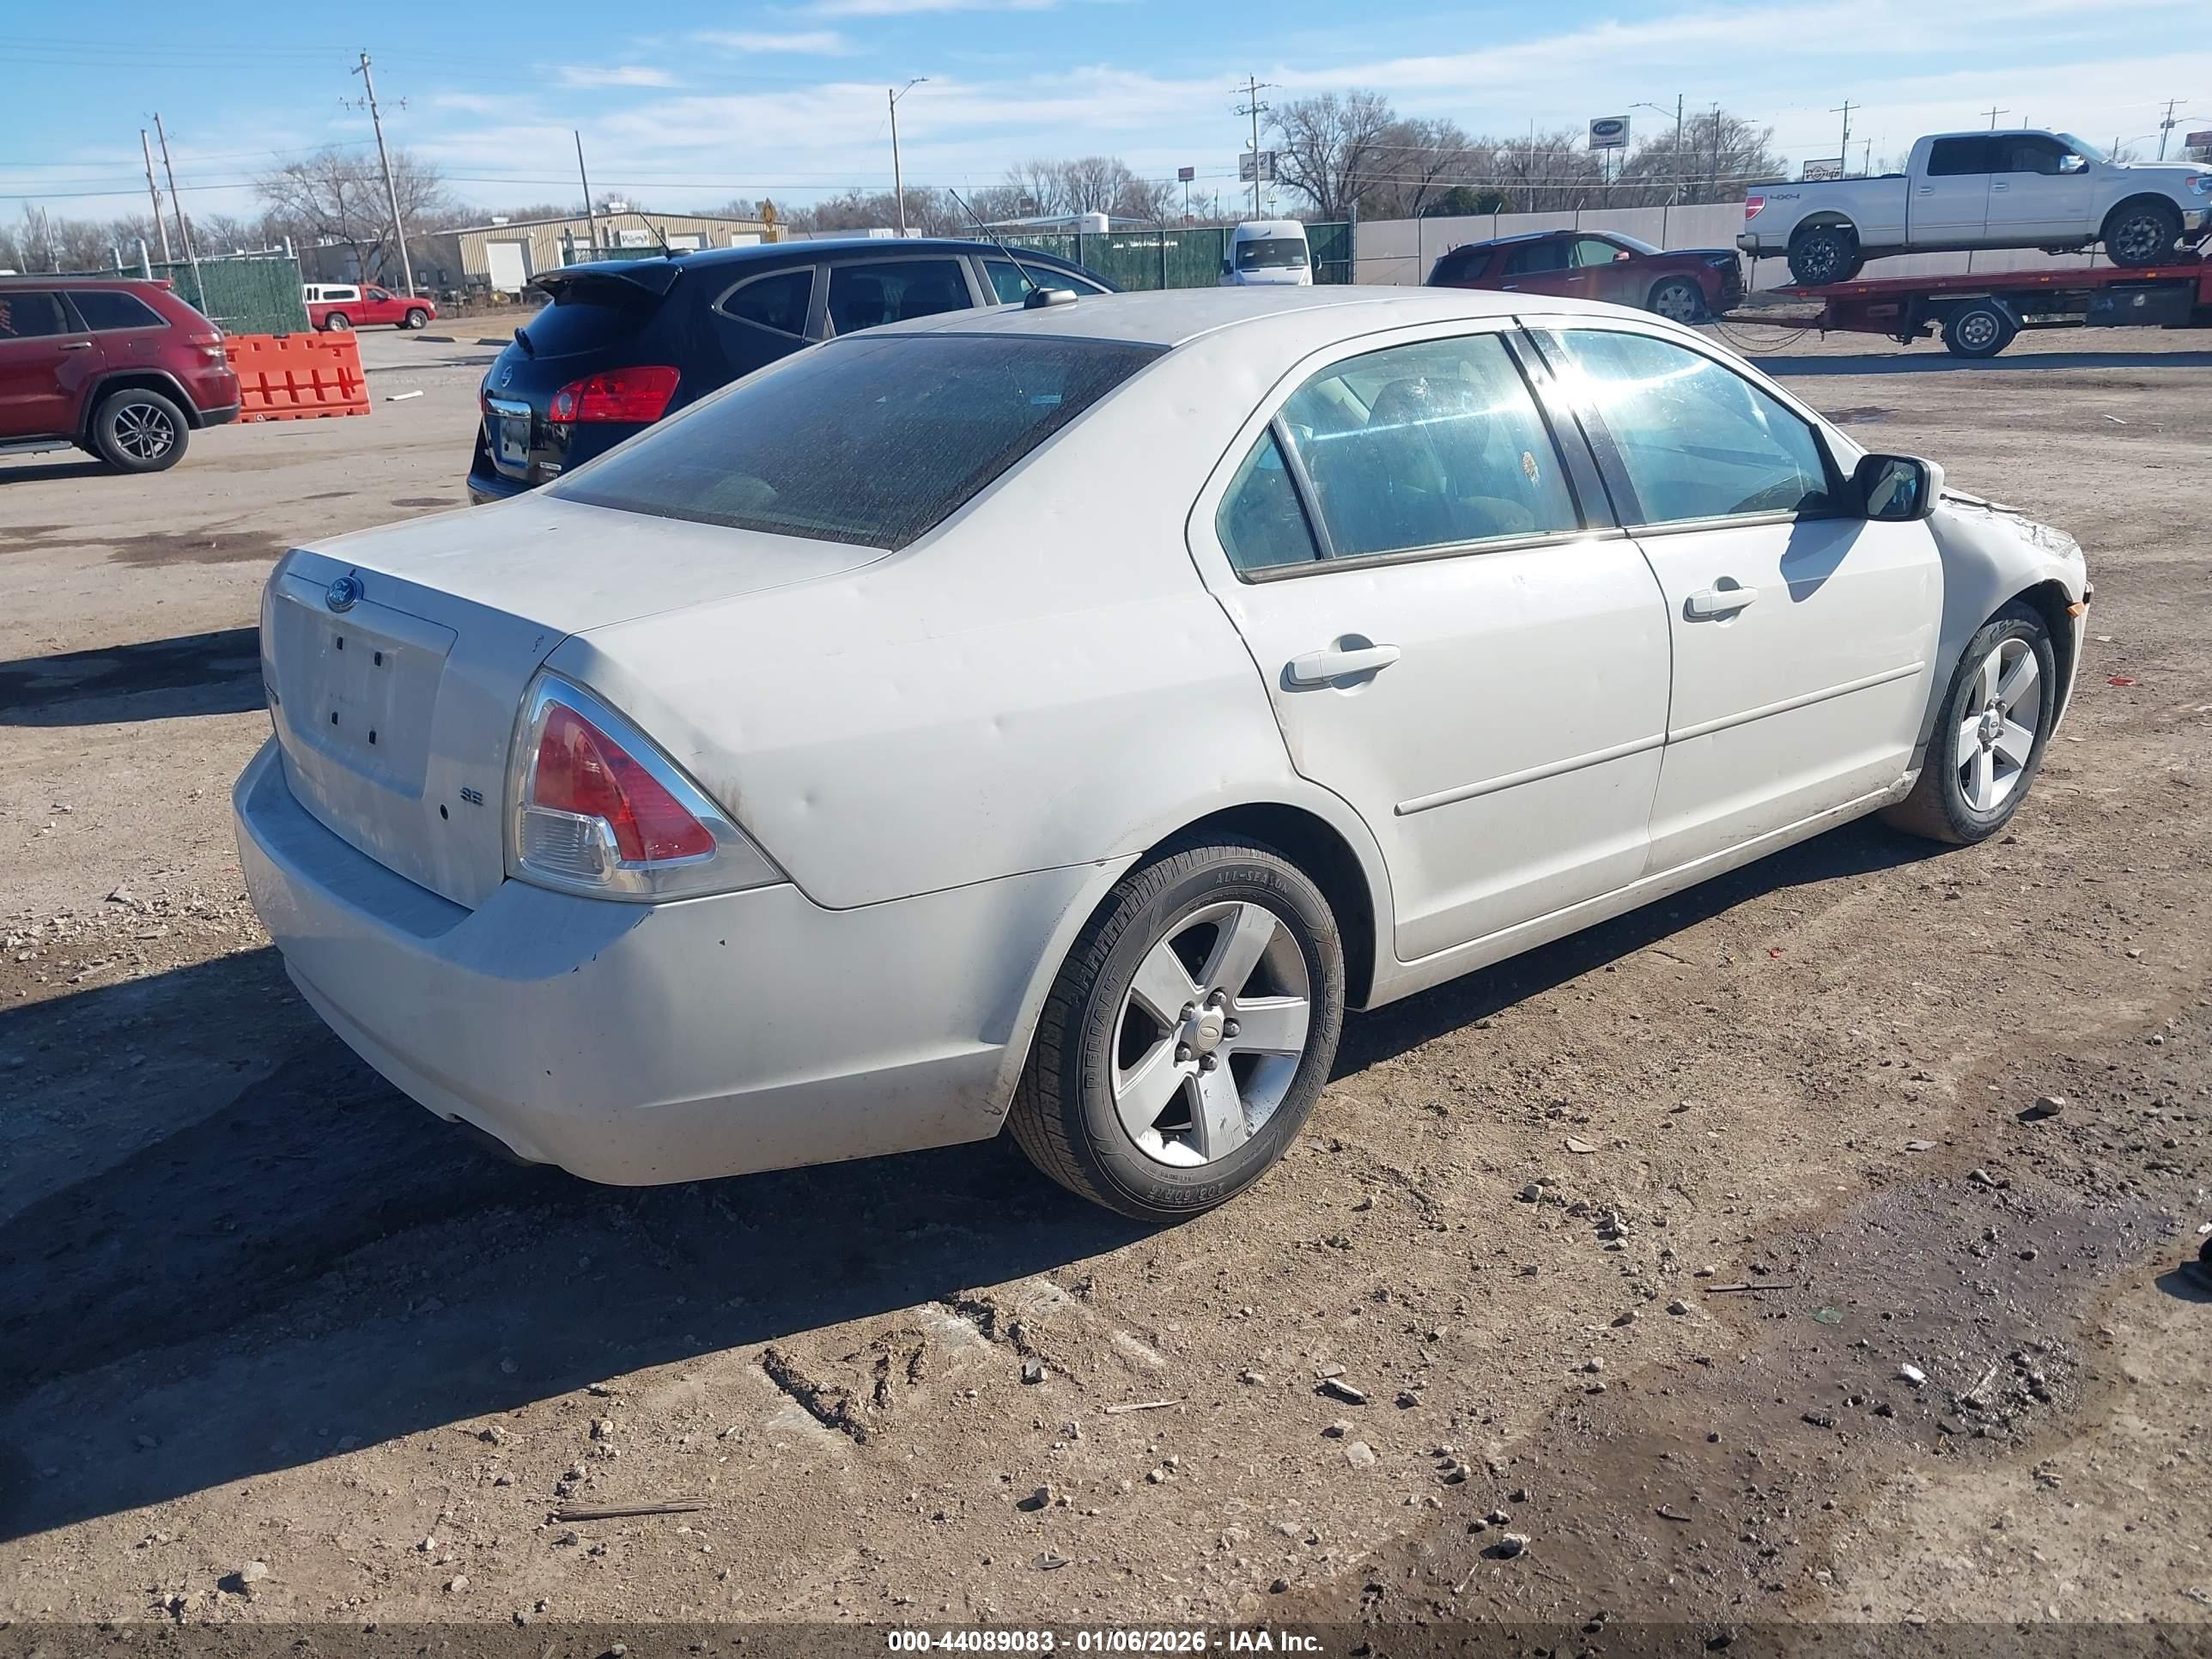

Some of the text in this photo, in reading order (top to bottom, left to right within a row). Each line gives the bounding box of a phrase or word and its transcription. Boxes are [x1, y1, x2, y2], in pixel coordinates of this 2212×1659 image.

[329, 580, 349, 602] Ford
[459, 787, 484, 806] SE
[1216, 869, 1291, 894] ALL-SEASON
[1084, 964, 1122, 1089] RELIANT
